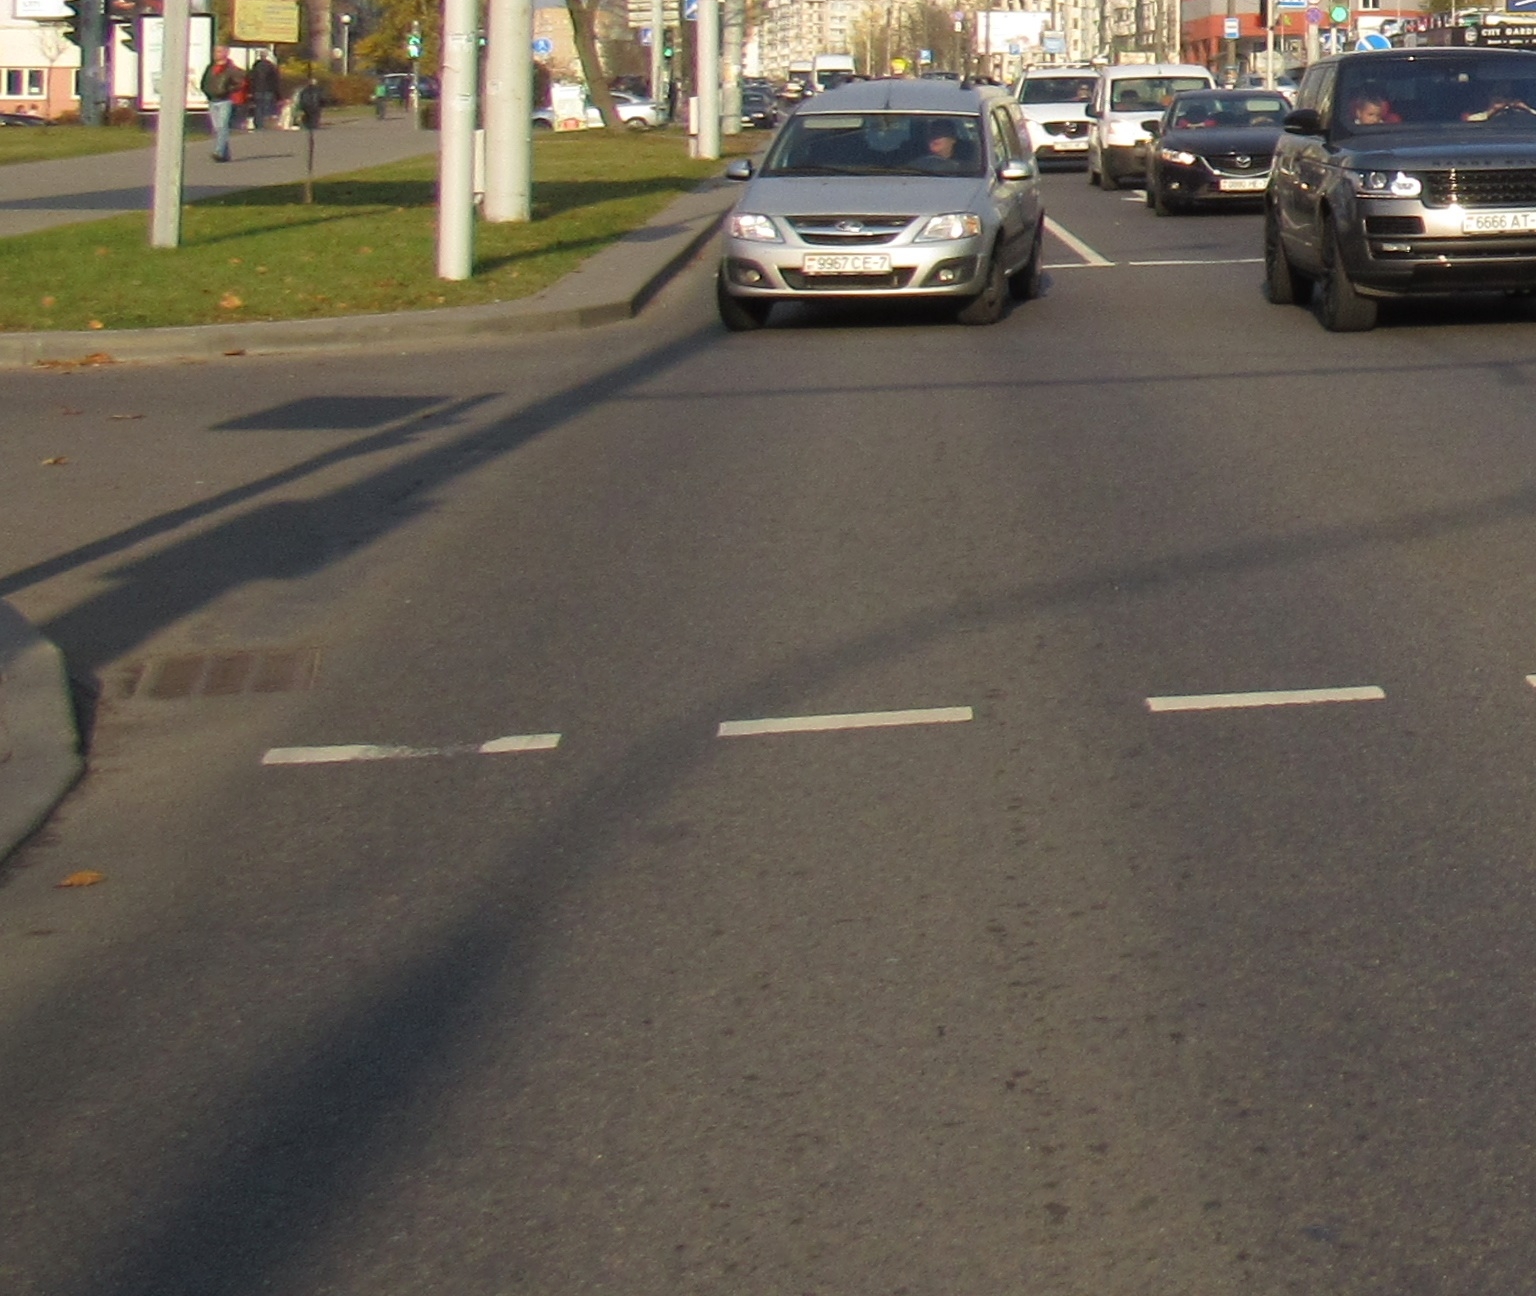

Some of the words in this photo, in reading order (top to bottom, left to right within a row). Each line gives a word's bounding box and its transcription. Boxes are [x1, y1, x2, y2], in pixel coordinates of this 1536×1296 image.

[1481, 28, 1501, 36] CITY
[1476, 215, 1507, 229] 6666
[817, 256, 848, 270] 9967
[850, 256, 888, 270] CE-7
